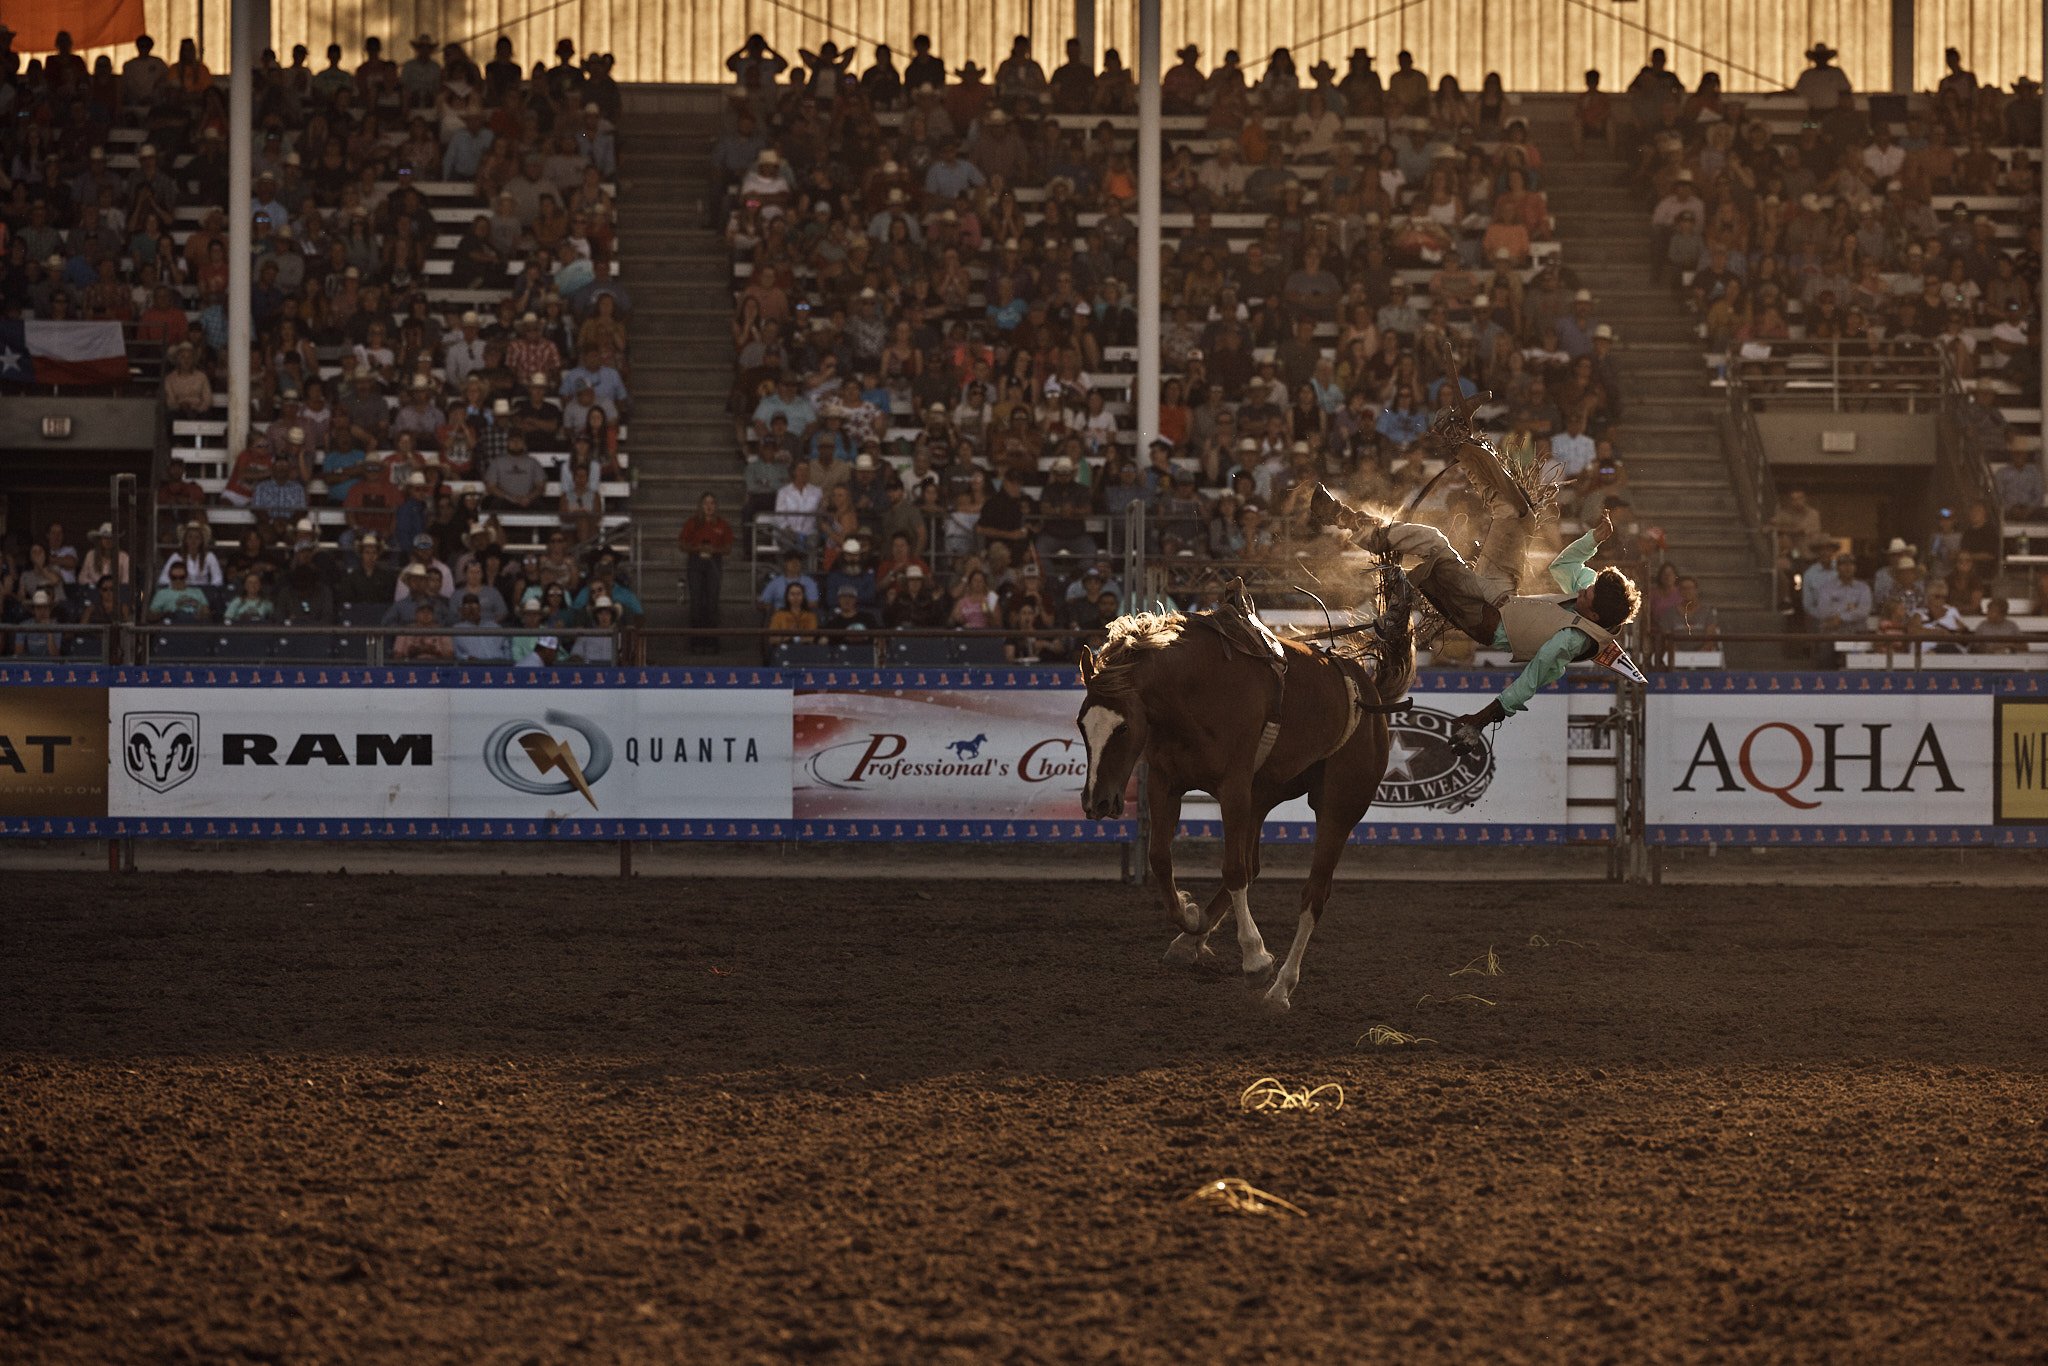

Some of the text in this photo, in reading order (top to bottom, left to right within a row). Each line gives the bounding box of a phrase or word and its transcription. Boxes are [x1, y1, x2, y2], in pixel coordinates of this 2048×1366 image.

[222, 733, 433, 766] RAM
[626, 737, 759, 765] QUANTA
[843, 733, 1086, 783] Professional's Choic
[1672, 721, 1966, 810] AQHA
[1420, 764, 1476, 799] WEAR
